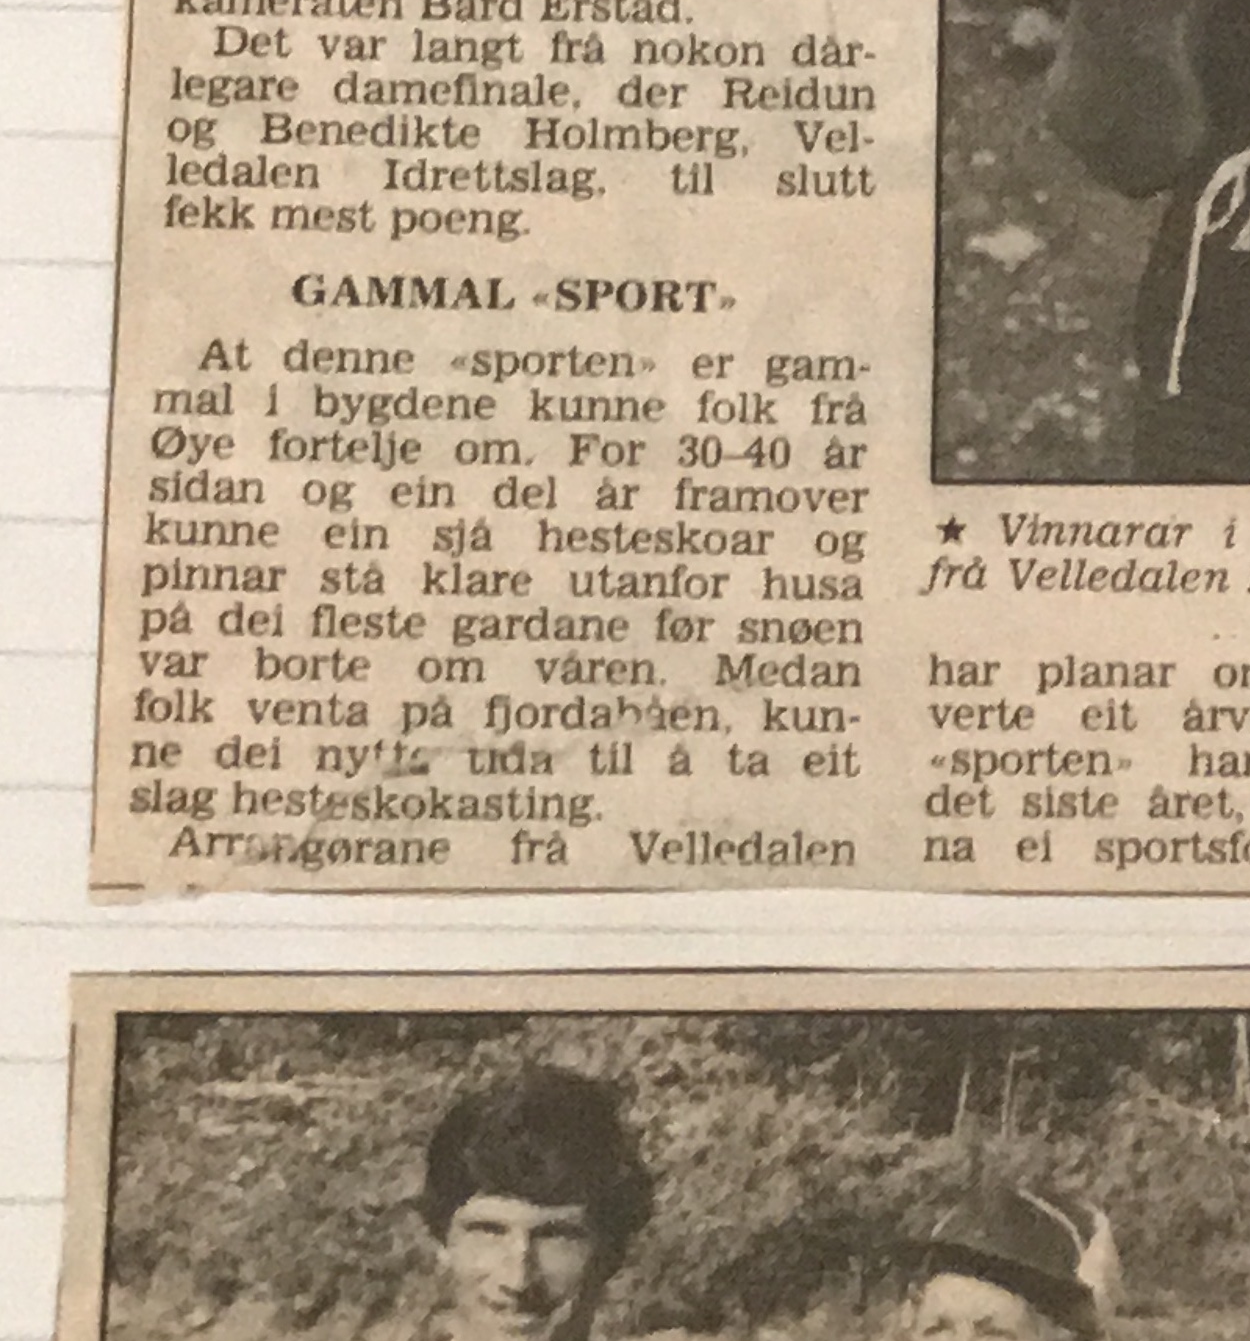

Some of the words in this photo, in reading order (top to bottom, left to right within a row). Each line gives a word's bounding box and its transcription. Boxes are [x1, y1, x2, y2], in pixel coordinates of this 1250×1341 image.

[167, 118, 218, 153] og
[260, 112, 480, 146] Benedikte
[525, 117, 748, 159] Holmberg,
[794, 120, 874, 153] Vel-
[166, 152, 319, 187] ledalen
[383, 158, 605, 200] Idrettslag,
[671, 162, 713, 194] til
[776, 163, 876, 196] slutt
[164, 194, 254, 229] fekk
[271, 200, 376, 231] mest
[390, 207, 530, 242] poeng.
[291, 277, 515, 310] GAMMAL
[198, 338, 251, 371] At
[283, 339, 414, 373] denne
[692, 354, 734, 378] er
[766, 355, 870, 388] gam-
[999, 513, 1193, 546] Vinnarar
[1224, 518, 1236, 548] i
[919, 556, 987, 598] frå
[1009, 558, 1229, 591] Velledalen
[929, 653, 1000, 686] har
[1037, 654, 1176, 695] planar
